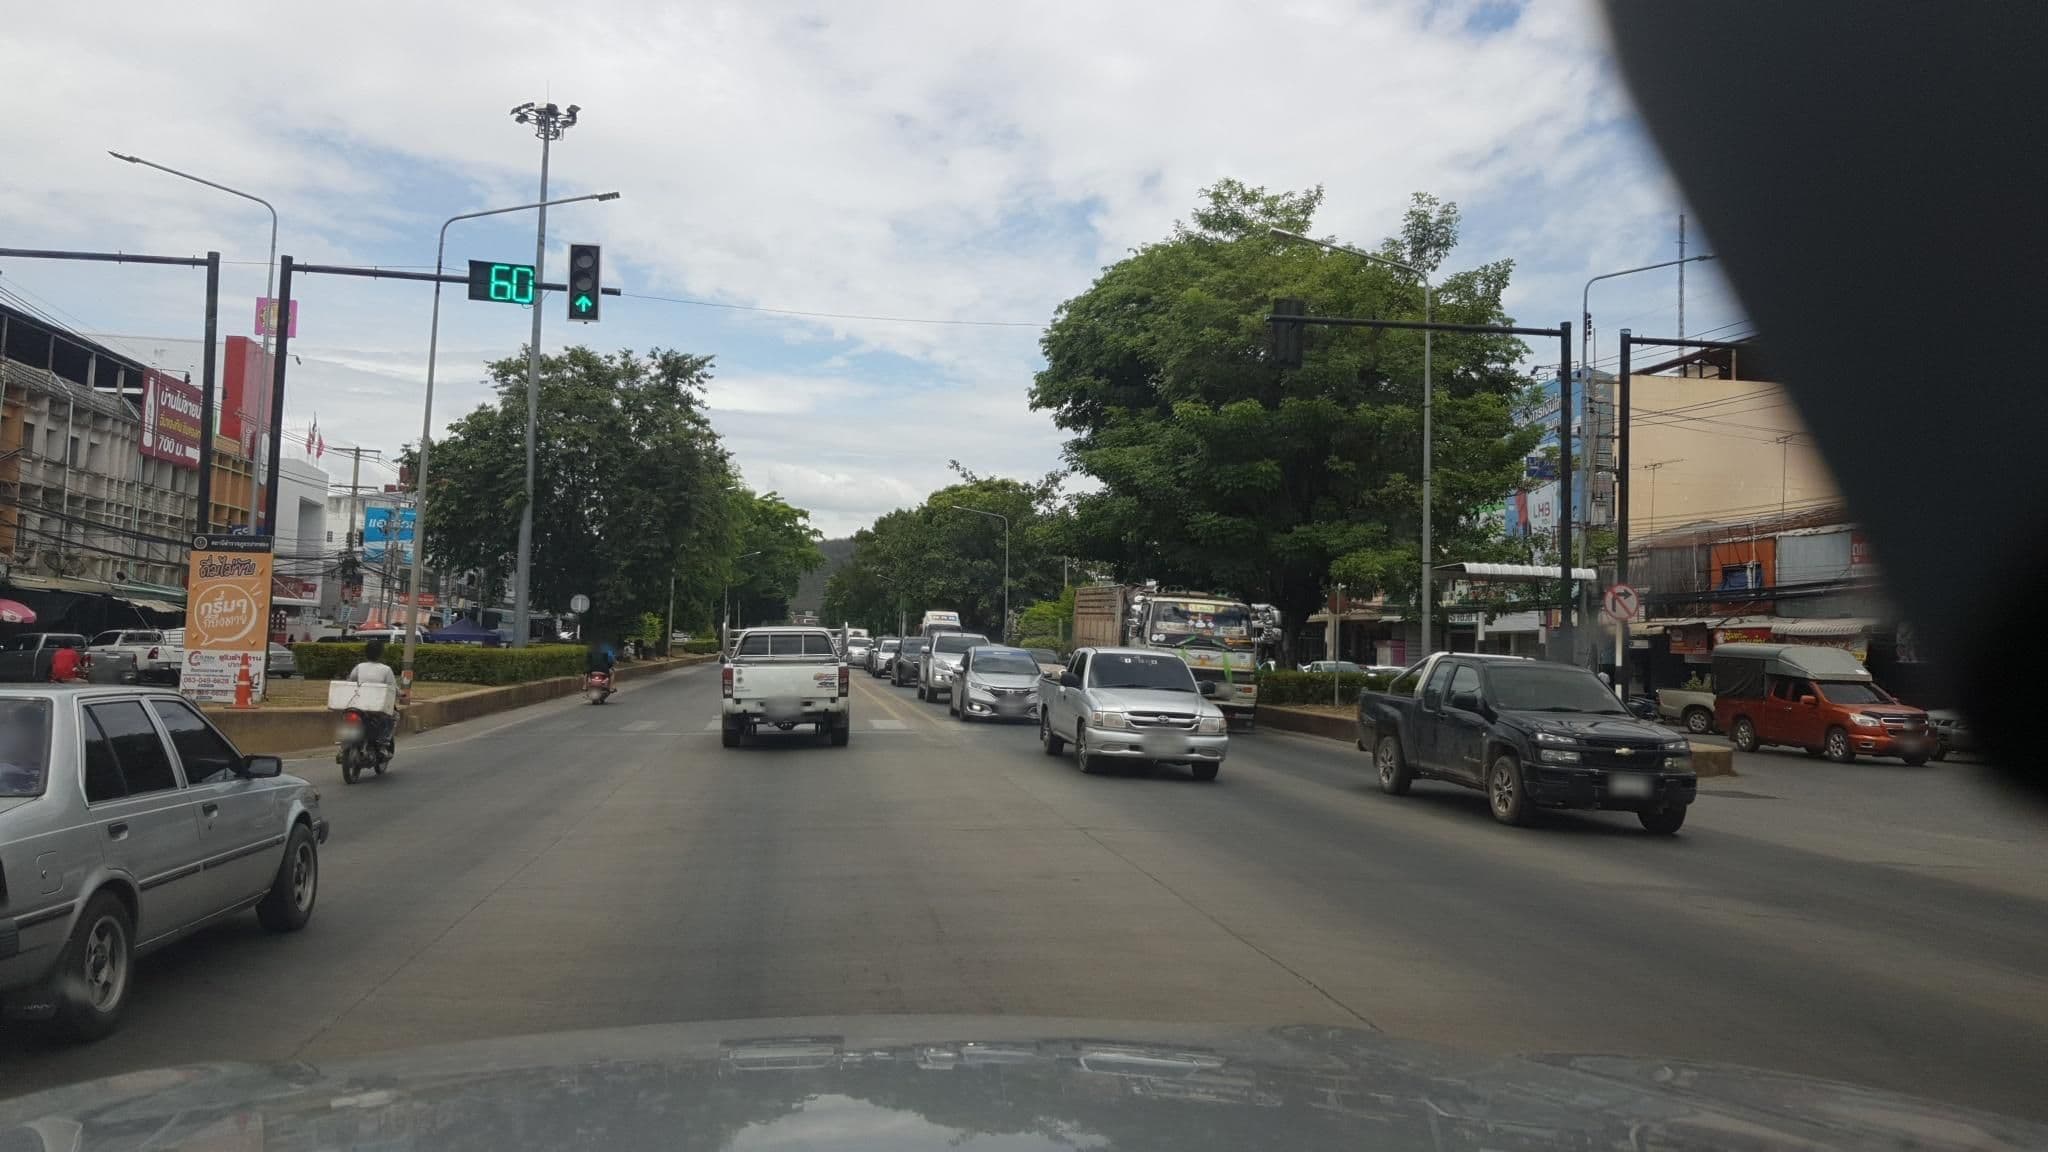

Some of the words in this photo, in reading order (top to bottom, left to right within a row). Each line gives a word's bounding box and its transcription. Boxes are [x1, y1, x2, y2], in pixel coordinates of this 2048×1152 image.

[489, 264, 534, 304] 60
[158, 437, 175, 454] 700
[199, 554, 256, 578] ดื่มไม่ขับ
